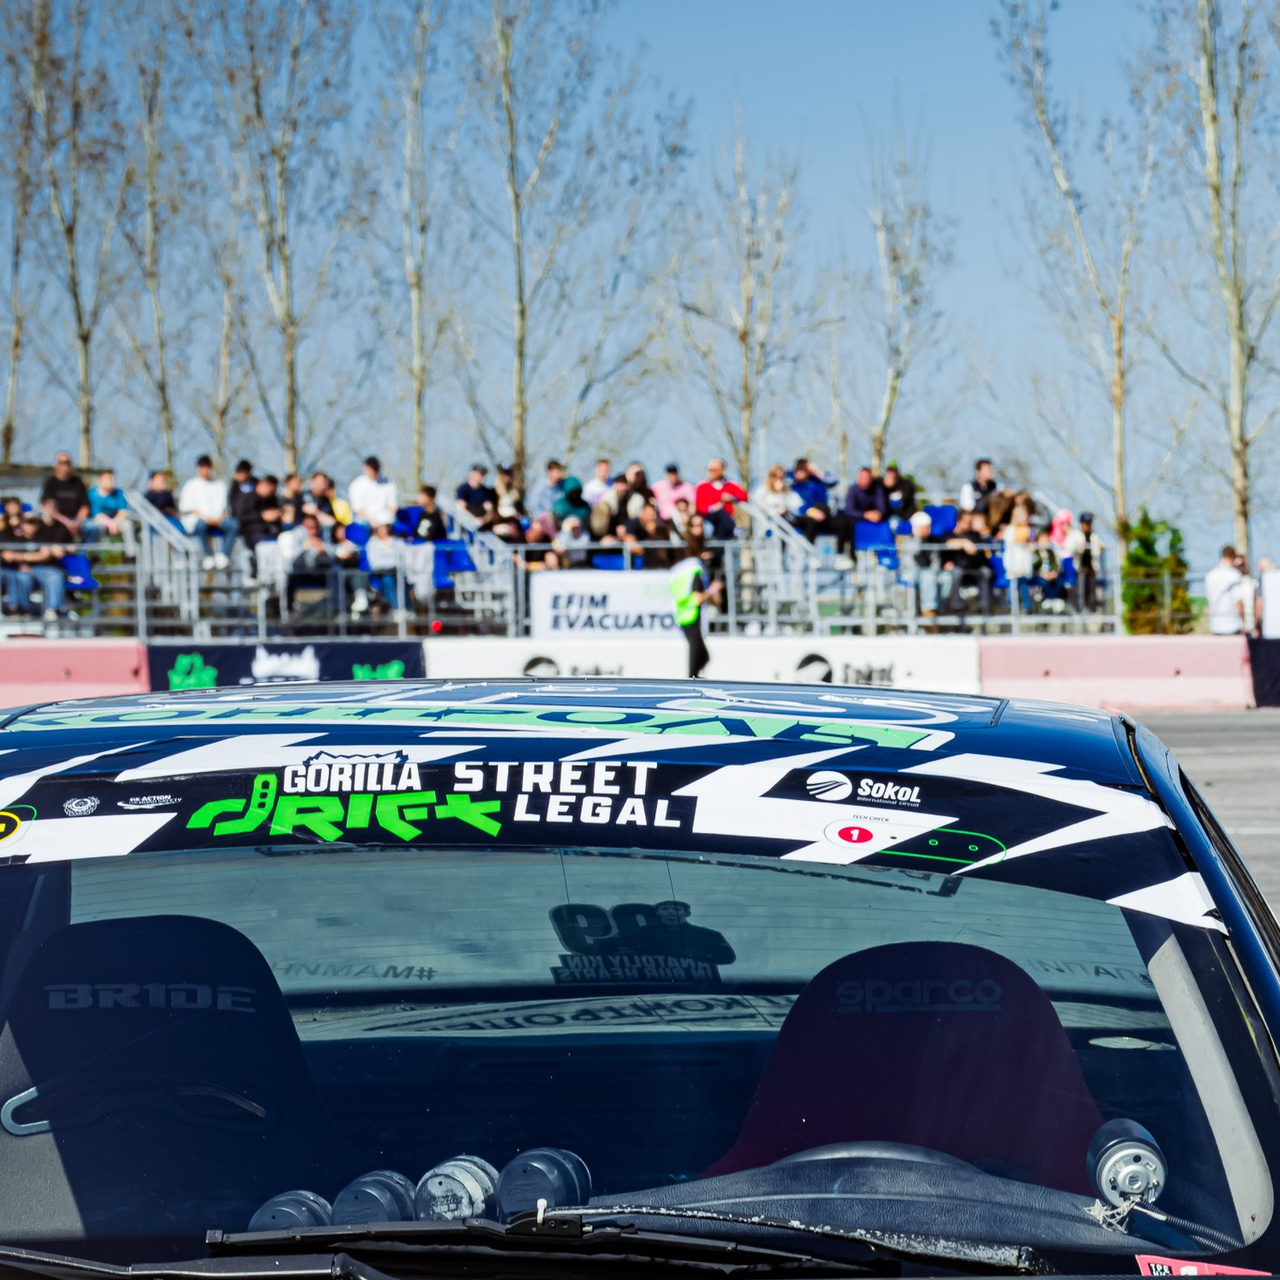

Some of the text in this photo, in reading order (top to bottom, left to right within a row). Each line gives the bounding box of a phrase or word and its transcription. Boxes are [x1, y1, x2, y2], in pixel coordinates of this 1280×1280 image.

[551, 594, 608, 610] EFIM
[551, 613, 675, 630] EVACUATO
[283, 761, 657, 796] GORILLA STREET
[141, 794, 172, 802] ACTION
[513, 797, 681, 829] LEGAL
[850, 828, 860, 841] 1
[44, 984, 256, 1013] BRIDE
[836, 978, 1003, 1013] sparco
